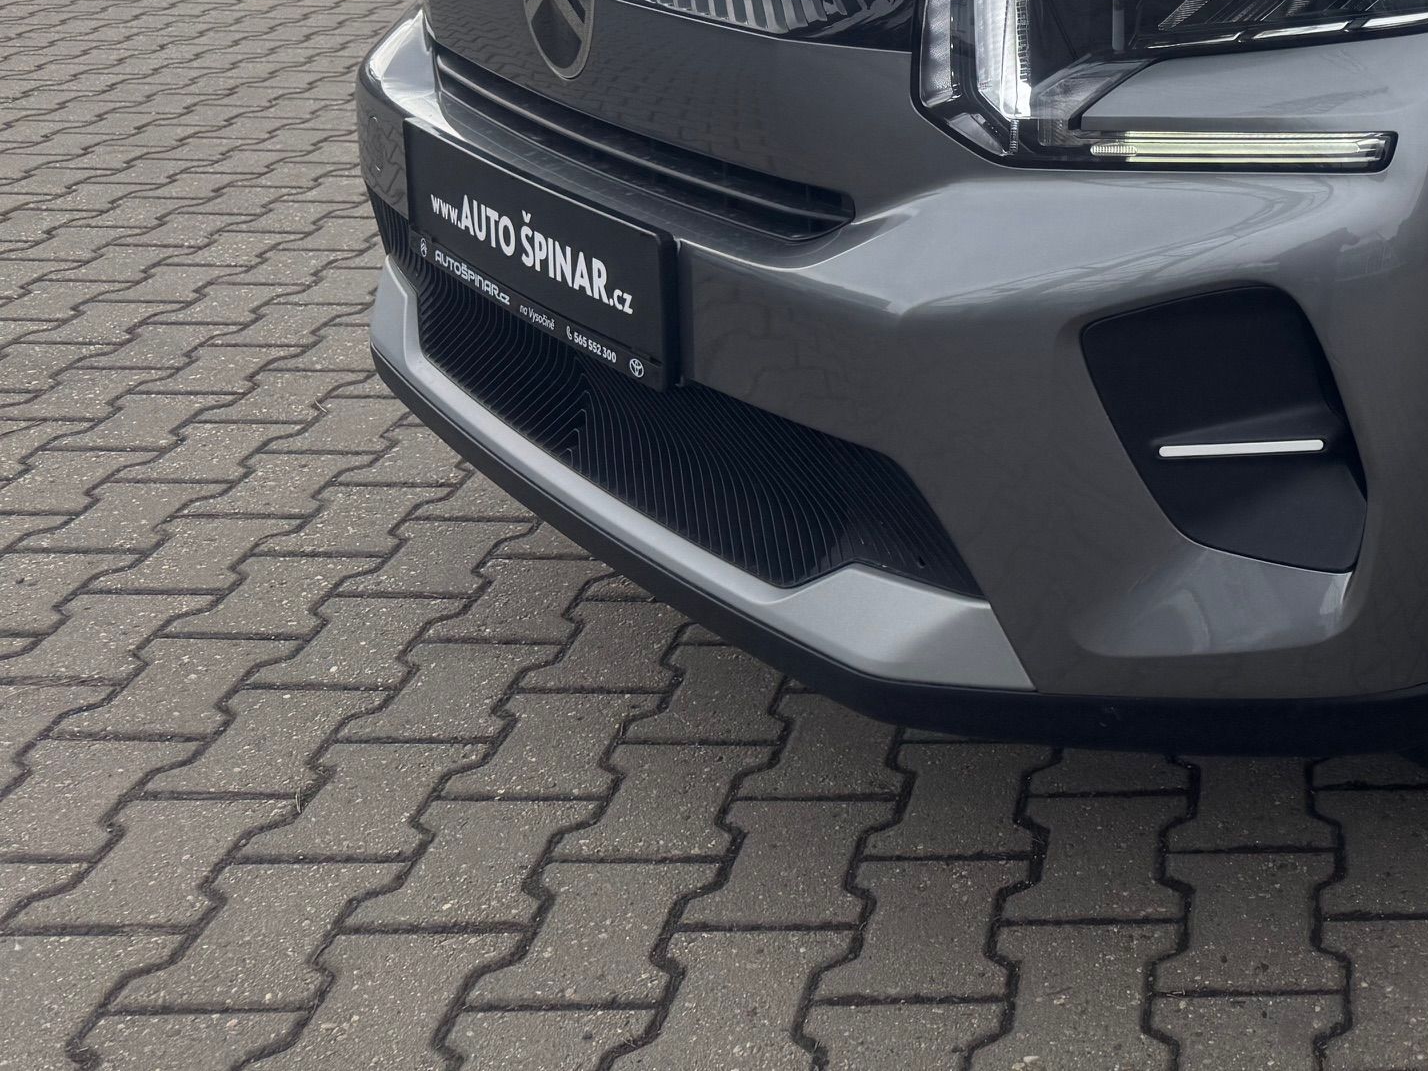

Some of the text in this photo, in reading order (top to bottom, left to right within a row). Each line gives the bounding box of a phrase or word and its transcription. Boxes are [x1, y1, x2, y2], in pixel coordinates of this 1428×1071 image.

[520, 210, 633, 314] ŠPINAR.cz
[574, 331, 588, 348] 565
[588, 338, 602, 355] 552
[602, 347, 617, 363] 300
